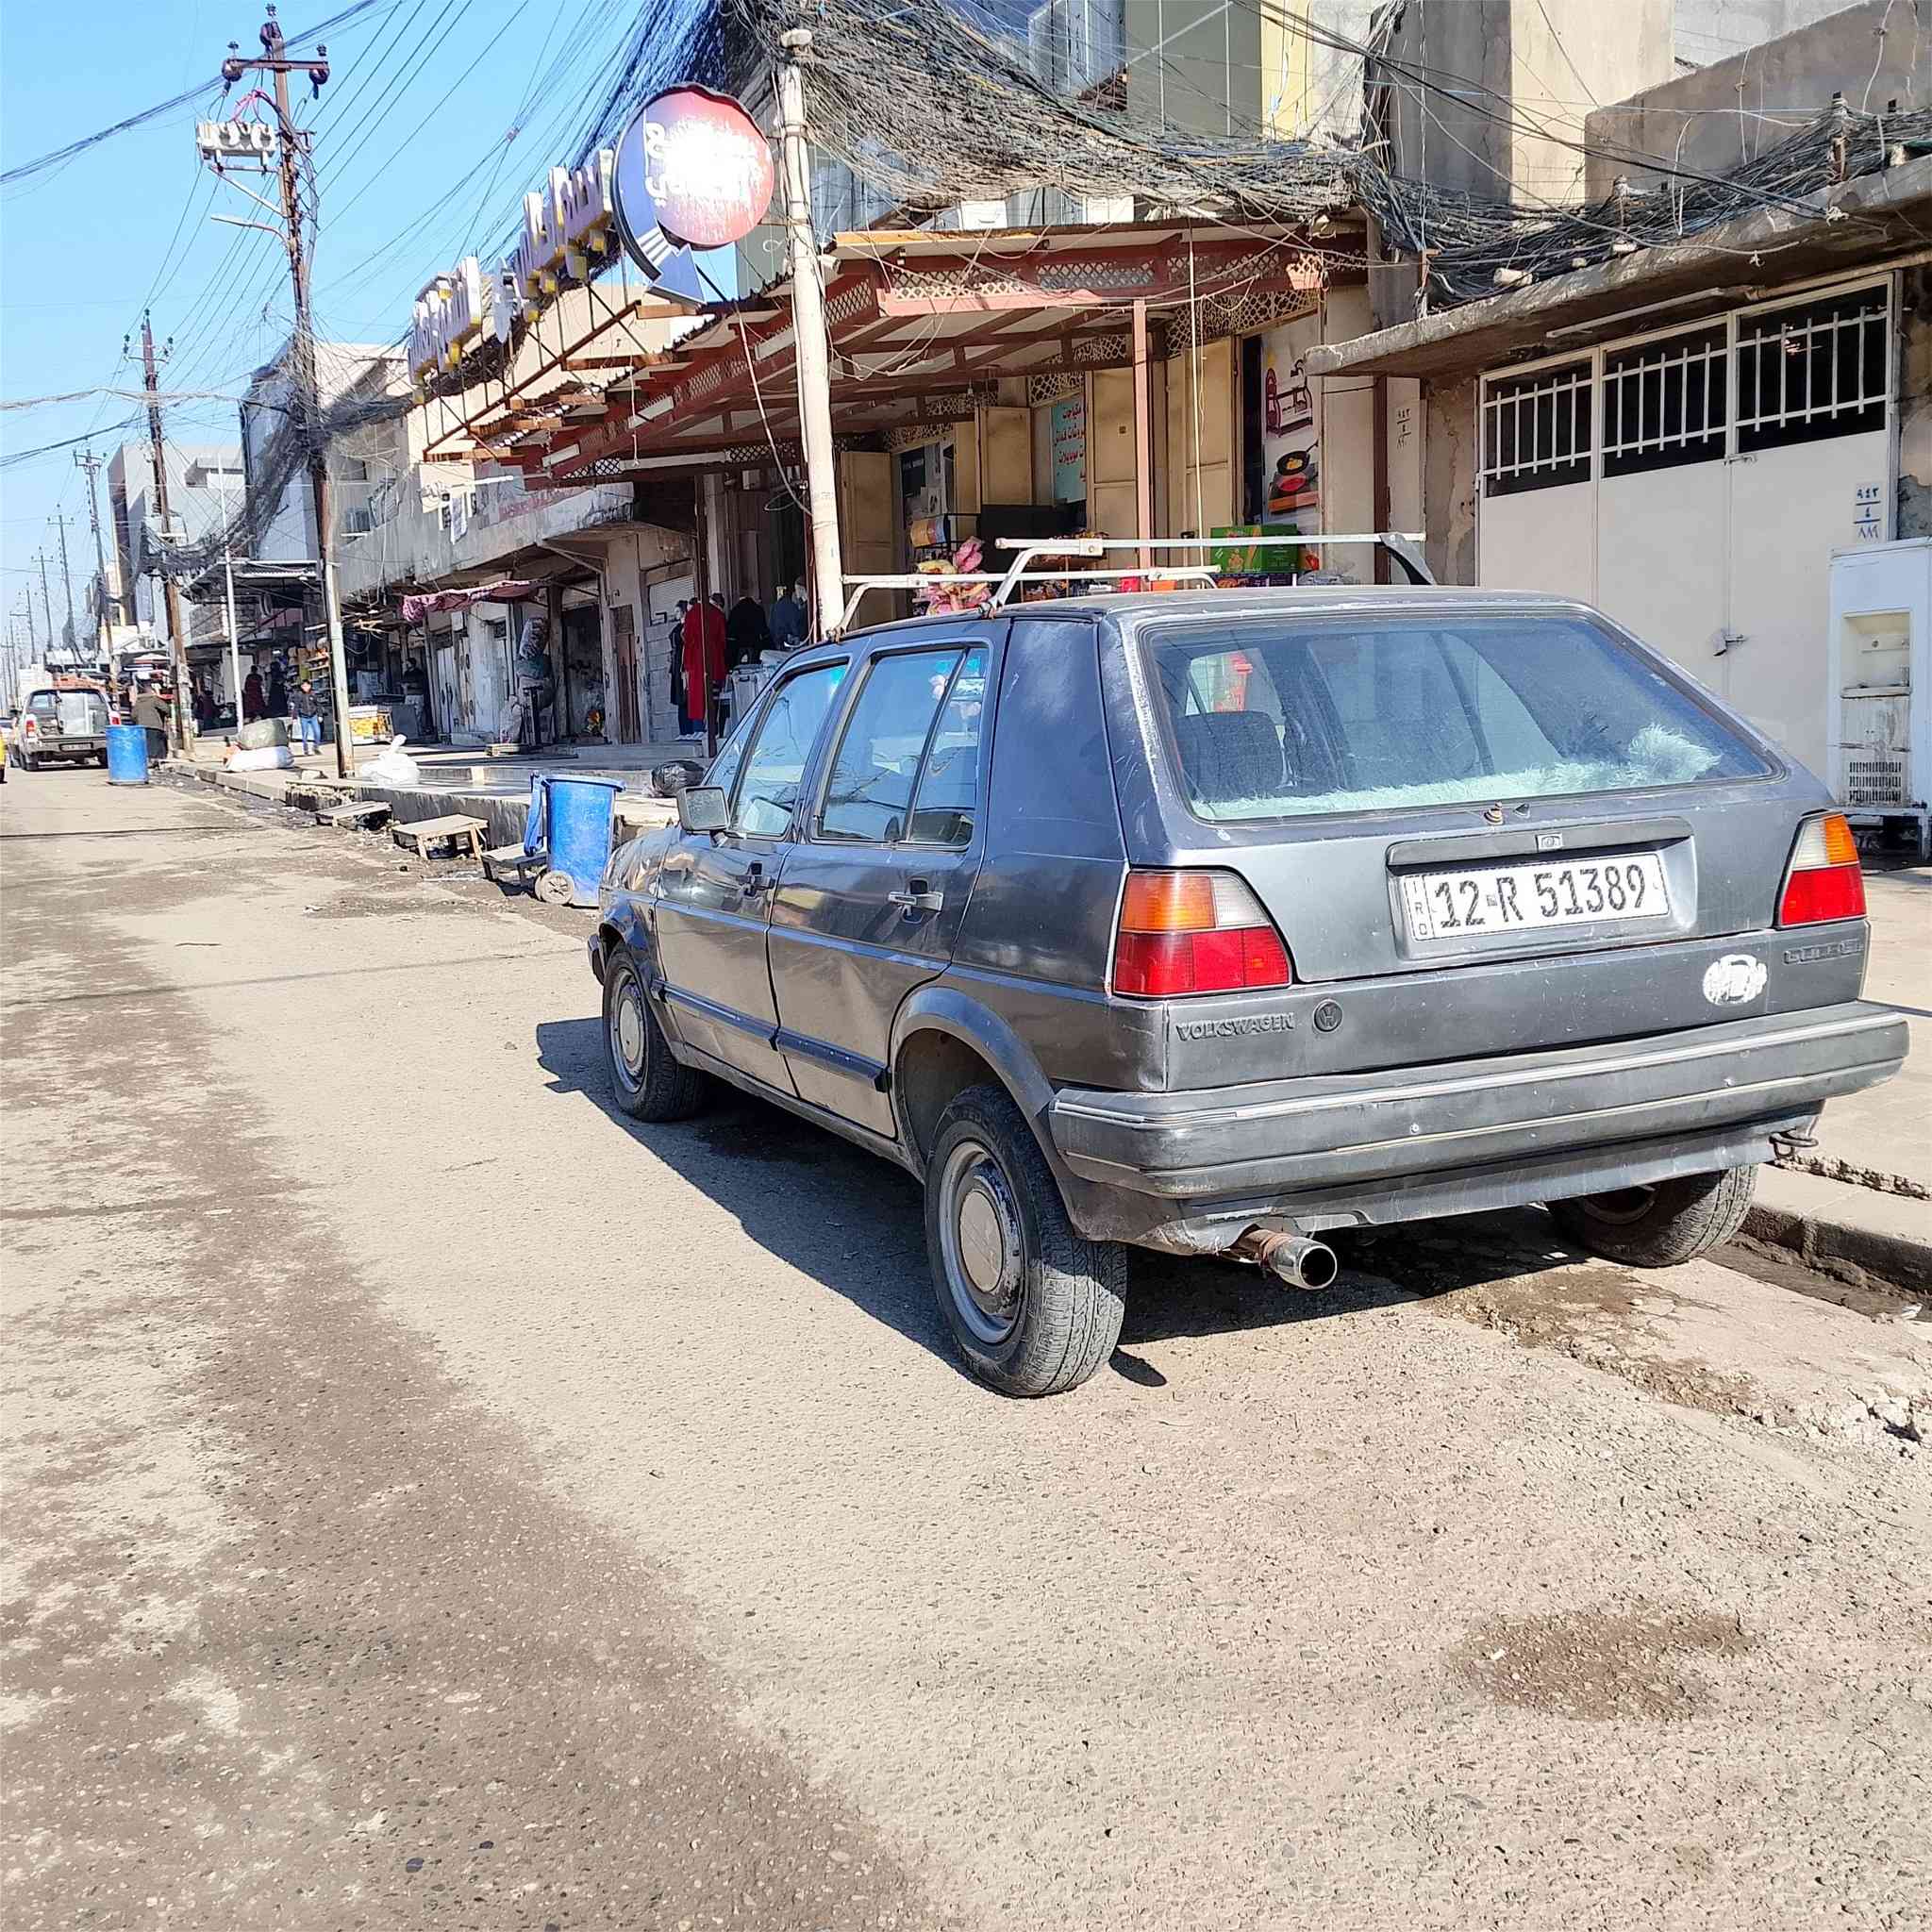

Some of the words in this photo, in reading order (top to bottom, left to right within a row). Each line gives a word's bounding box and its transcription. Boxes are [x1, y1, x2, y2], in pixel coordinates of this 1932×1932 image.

[1435, 879, 1486, 929] 12
[1496, 876, 1524, 923] R
[1534, 864, 1646, 918] 51389
[1175, 1012, 1295, 1041] VOLKSWAGEN
